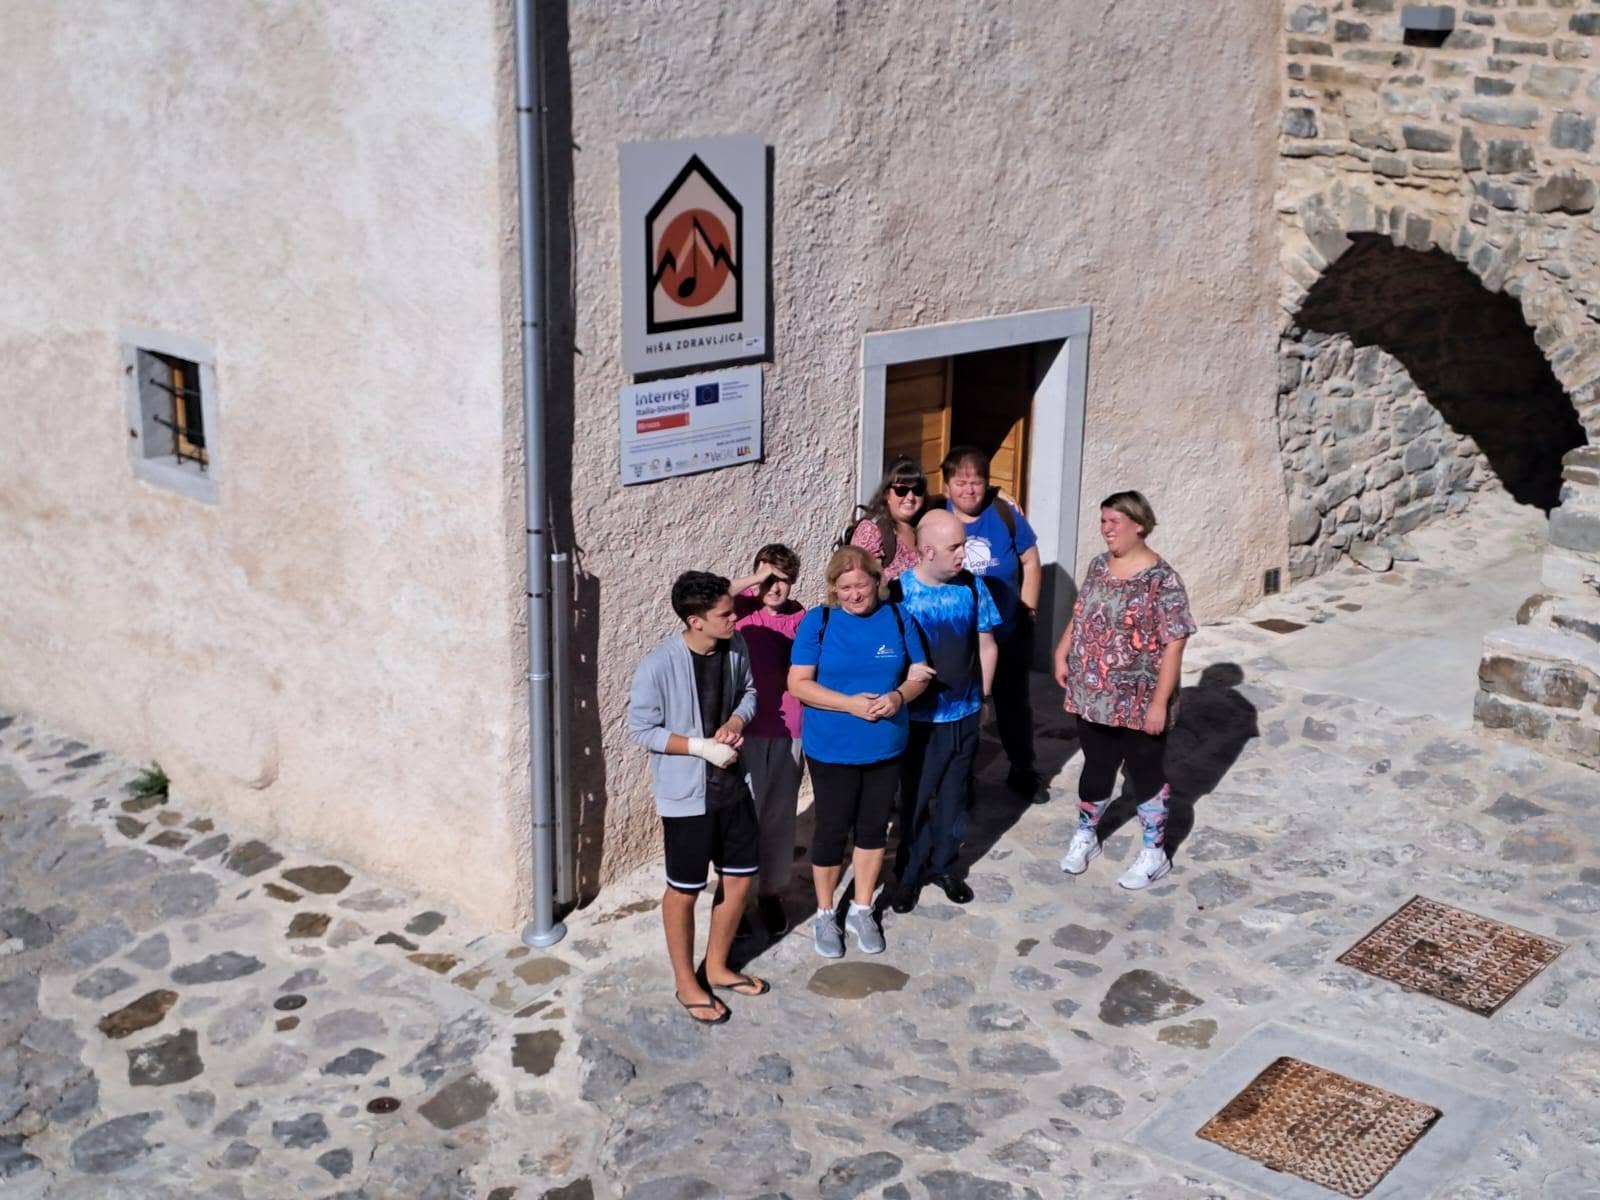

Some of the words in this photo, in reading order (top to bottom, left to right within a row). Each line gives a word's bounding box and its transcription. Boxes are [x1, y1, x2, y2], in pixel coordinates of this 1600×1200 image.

[646, 342, 672, 354] HIŠA
[676, 332, 744, 351] ZDRAVLJICA
[635, 388, 690, 407] Interreg
